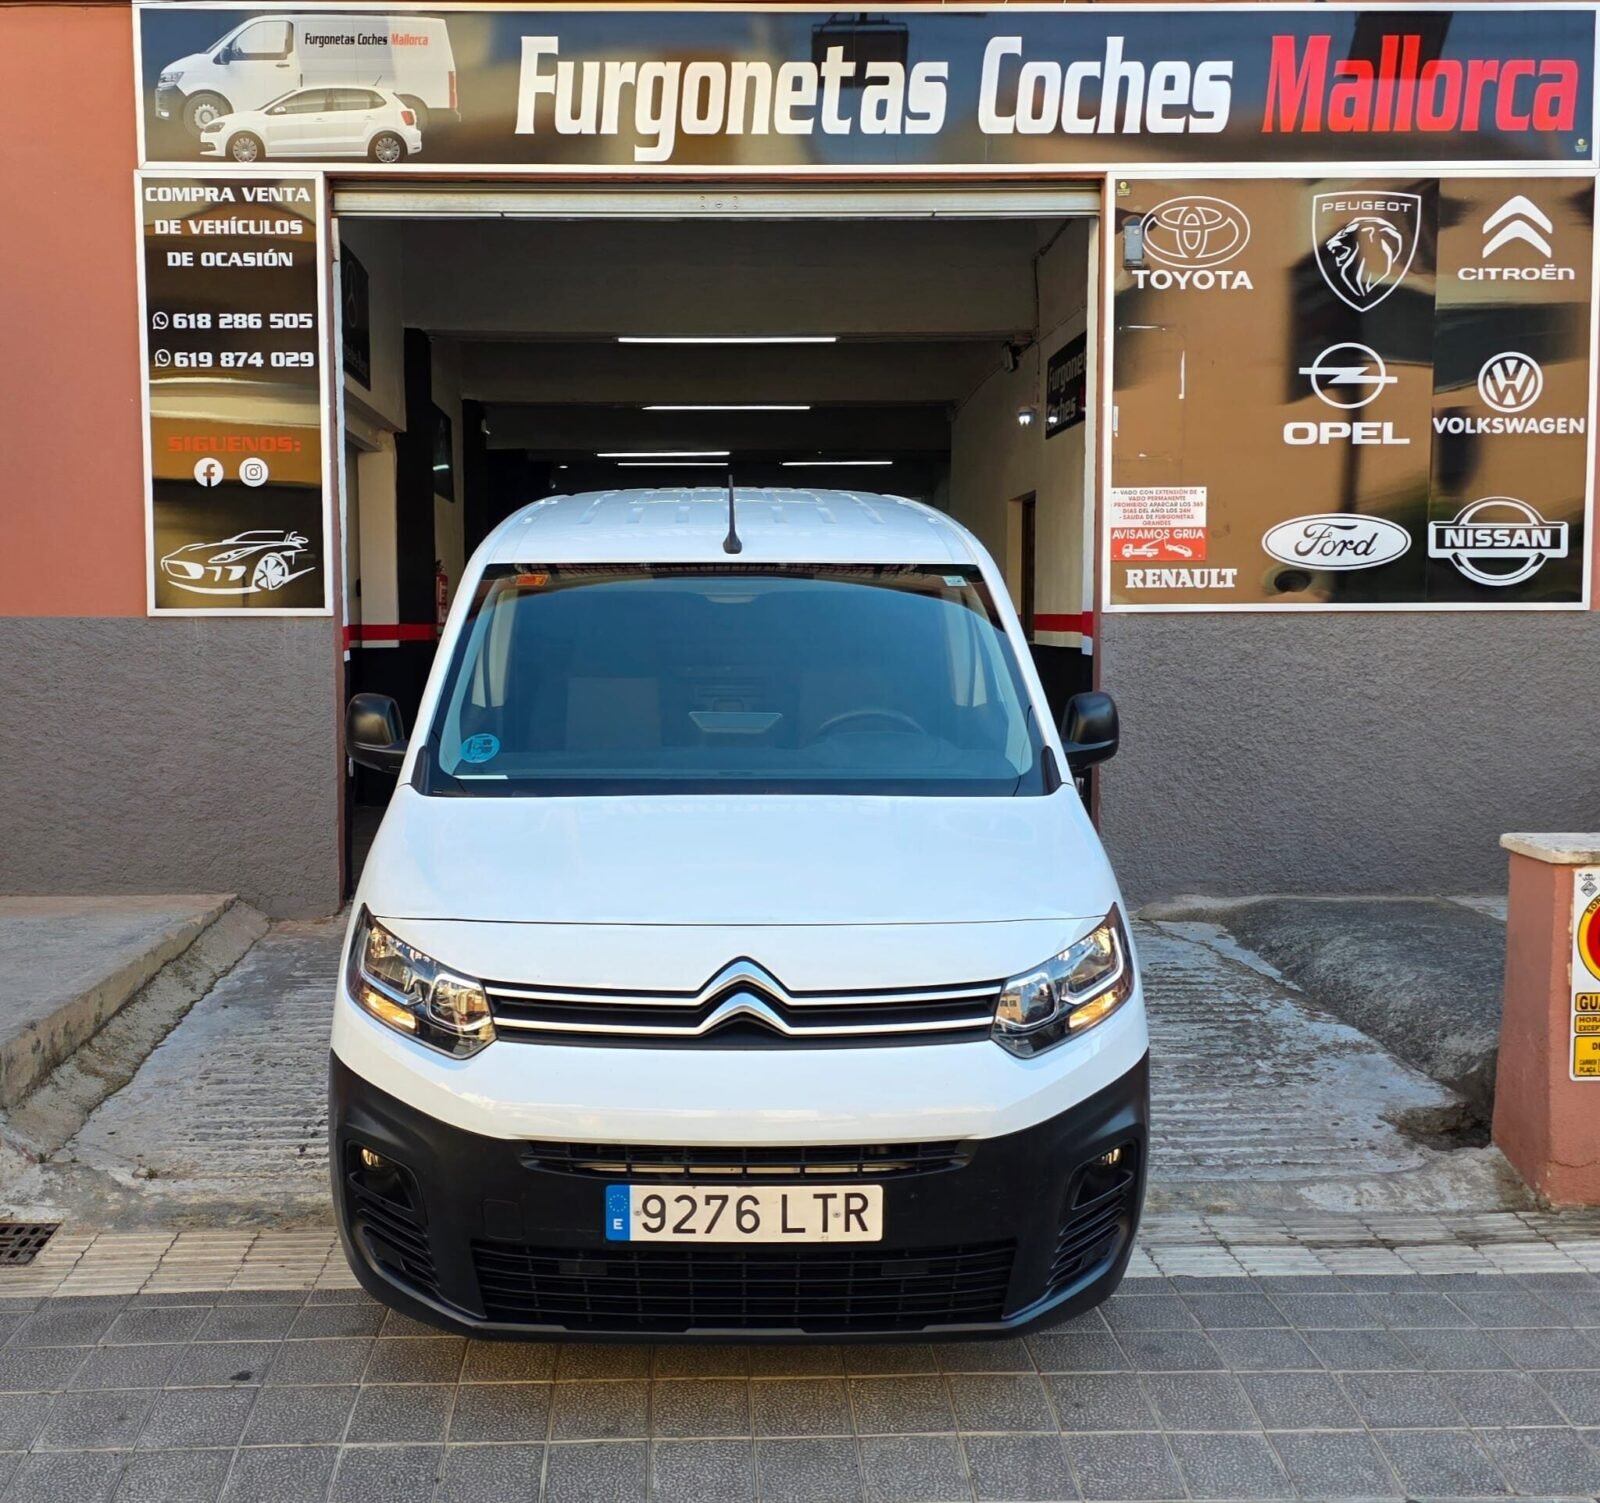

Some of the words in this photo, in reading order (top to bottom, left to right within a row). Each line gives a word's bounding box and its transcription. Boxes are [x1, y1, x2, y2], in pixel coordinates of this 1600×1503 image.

[305, 33, 355, 48] Furgonetas
[357, 33, 388, 46] Coches
[391, 33, 429, 46] Mallorca
[514, 36, 949, 161] Furgonetas
[978, 36, 1233, 134] Coches
[1261, 35, 1578, 132] Mallorca
[145, 187, 236, 202] COMPRA
[241, 187, 311, 202] VENTA
[1322, 201, 1412, 213] PEUGEOT
[155, 220, 182, 235] DE
[188, 216, 303, 235] VEHÍCULOS
[167, 252, 194, 267] DE
[200, 249, 293, 267] OCASIÓN
[1132, 269, 1254, 290] TOYOTA
[173, 313, 211, 329] 618
[218, 313, 262, 329] 286
[270, 313, 313, 329] 505
[174, 352, 213, 367] 619
[220, 352, 264, 367] 874
[270, 352, 315, 367] 029
[1283, 422, 1410, 445] OPEL
[1432, 417, 1585, 434] VOLKSWAGEN
[1112, 529, 1170, 540] AVISAMOS
[1173, 529, 1205, 539] GRUA
[1294, 522, 1379, 558] Ford
[1444, 528, 1551, 548] NISSAN
[1125, 568, 1238, 588] RENAULT
[1580, 995, 1600, 1010] GU
[613, 1219, 623, 1230] E
[641, 1194, 761, 1234] 9276
[781, 1192, 869, 1233] LTR
